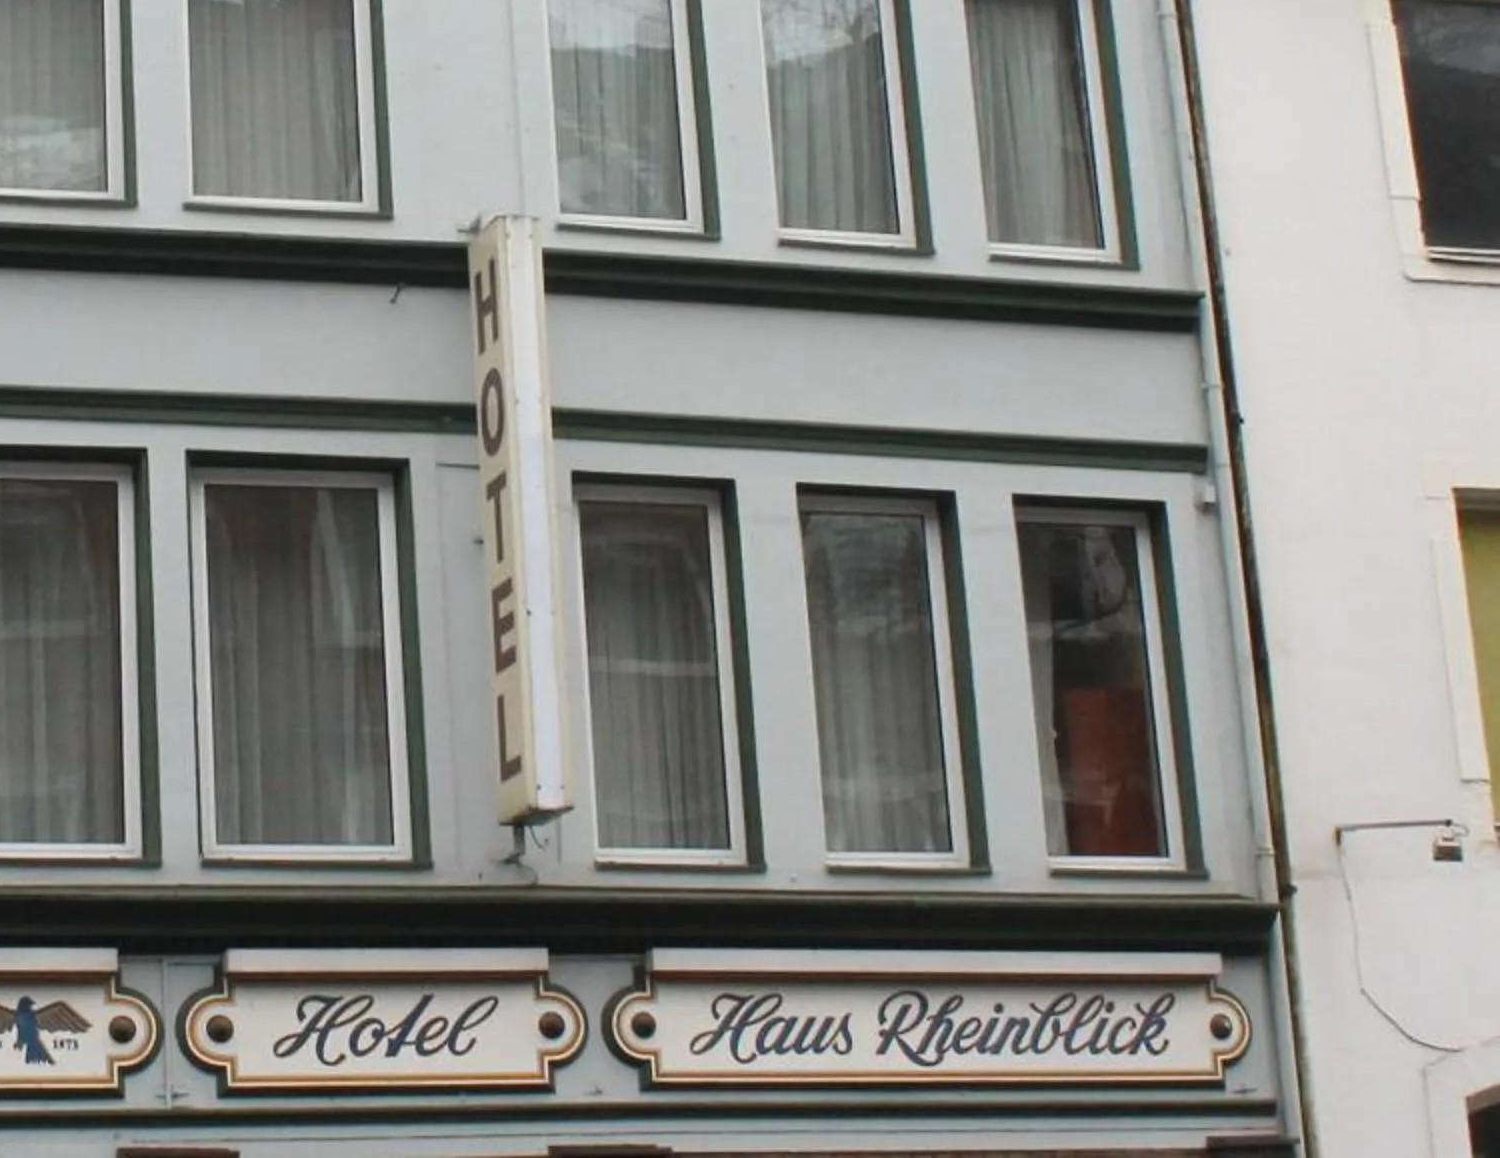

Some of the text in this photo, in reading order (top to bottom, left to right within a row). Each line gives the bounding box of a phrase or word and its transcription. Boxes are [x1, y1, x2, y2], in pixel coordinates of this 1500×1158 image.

[473, 258, 523, 784] HOTEL
[273, 993, 499, 1067] Hotel
[689, 989, 1176, 1067] Haus Rheinblick
